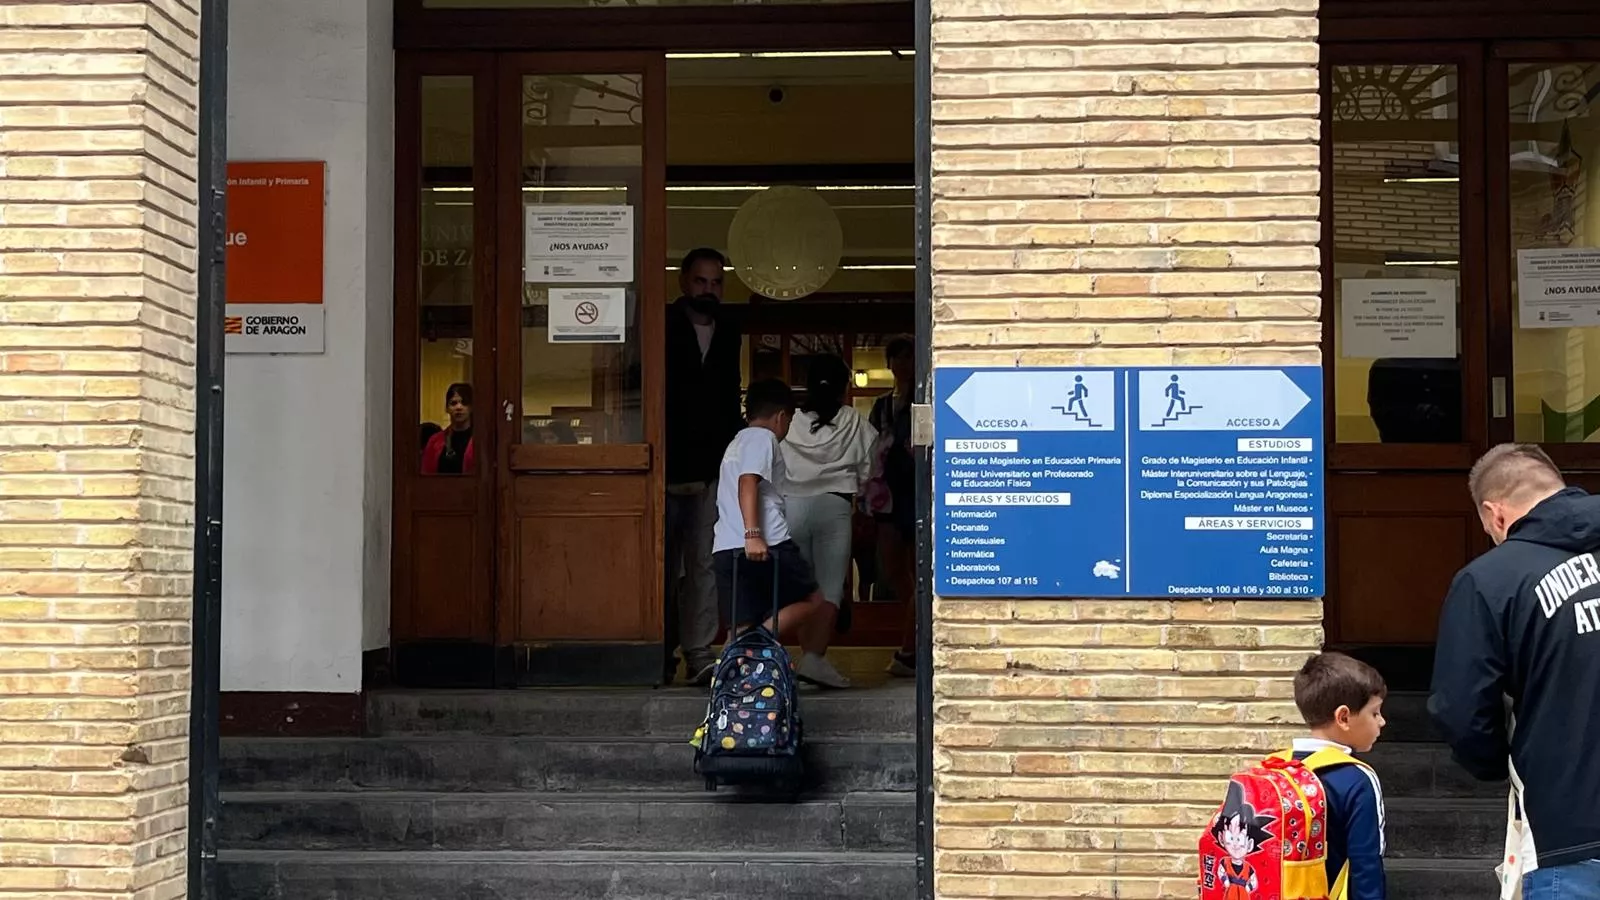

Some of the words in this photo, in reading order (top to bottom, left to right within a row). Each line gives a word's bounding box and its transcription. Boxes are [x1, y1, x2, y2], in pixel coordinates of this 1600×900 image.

[268, 179, 273, 187] y
[549, 243, 571, 251] ¿NOS
[572, 243, 609, 251] AYUDAS?
[1544, 287, 1566, 295] ¿NOS
[246, 316, 298, 325] GOBIERNO
[246, 326, 259, 335] DE
[263, 326, 306, 335] ARAGON
[976, 419, 1018, 428] ACCESO
[1227, 418, 1270, 427] ACCESO
[1272, 418, 1280, 426] A
[956, 441, 1007, 450] ESTUDIOS
[1249, 440, 1301, 448] ESTUDIOS
[951, 457, 976, 465] Grado
[977, 457, 988, 465] de
[990, 457, 1031, 467] Magisterio
[1044, 457, 1086, 465] Educación
[1087, 457, 1121, 465] Primaria
[1142, 456, 1167, 465] Grado
[1168, 456, 1179, 464] de
[1181, 456, 1223, 466] Magisterio
[1237, 456, 1279, 464] Educación
[1281, 456, 1308, 464] Infantil
[951, 470, 978, 478] Máster
[980, 470, 1031, 478] Universitario
[1044, 470, 1094, 478] Profesorado
[1142, 470, 1168, 478] Máster
[1170, 470, 1234, 478] Interuniversitario
[1236, 470, 1258, 478] sobre
[963, 479, 1005, 487] Educación
[1007, 479, 1031, 487] Física
[1177, 479, 1185, 487] la
[1186, 479, 1242, 487] Comunicación
[1266, 479, 1308, 489] Patologías
[958, 493, 994, 503] ÁREAS
[997, 495, 1003, 503] Y
[1005, 495, 1059, 503] SERVICIOS
[1141, 491, 1173, 500] Diploma
[1174, 490, 1233, 500] Especialización
[1234, 491, 1264, 500] Lengua
[1266, 491, 1308, 500] Aragonesa
[1234, 504, 1261, 512] Máster
[1276, 504, 1308, 512] Museos
[951, 510, 997, 518] Información
[1198, 517, 1234, 527] ÁREAS
[1247, 519, 1302, 528] SERVICIOS
[951, 524, 989, 532] Decanato
[951, 537, 1005, 545] Audiovisuales
[951, 550, 994, 558] Informática
[1260, 546, 1278, 554] Aula
[1280, 546, 1308, 555] Magna
[951, 577, 995, 586] Despachos
[997, 577, 1011, 585] 107
[1014, 577, 1021, 585] al
[1023, 577, 1037, 585] 115
[1269, 573, 1308, 581] Biblioteca
[1168, 586, 1213, 595] Despachos
[1215, 586, 1230, 594] 100
[1232, 586, 1239, 594] al
[1243, 586, 1257, 594] 106
[1266, 586, 1281, 594] 300
[1283, 586, 1291, 594] al
[1293, 586, 1308, 594] 310
